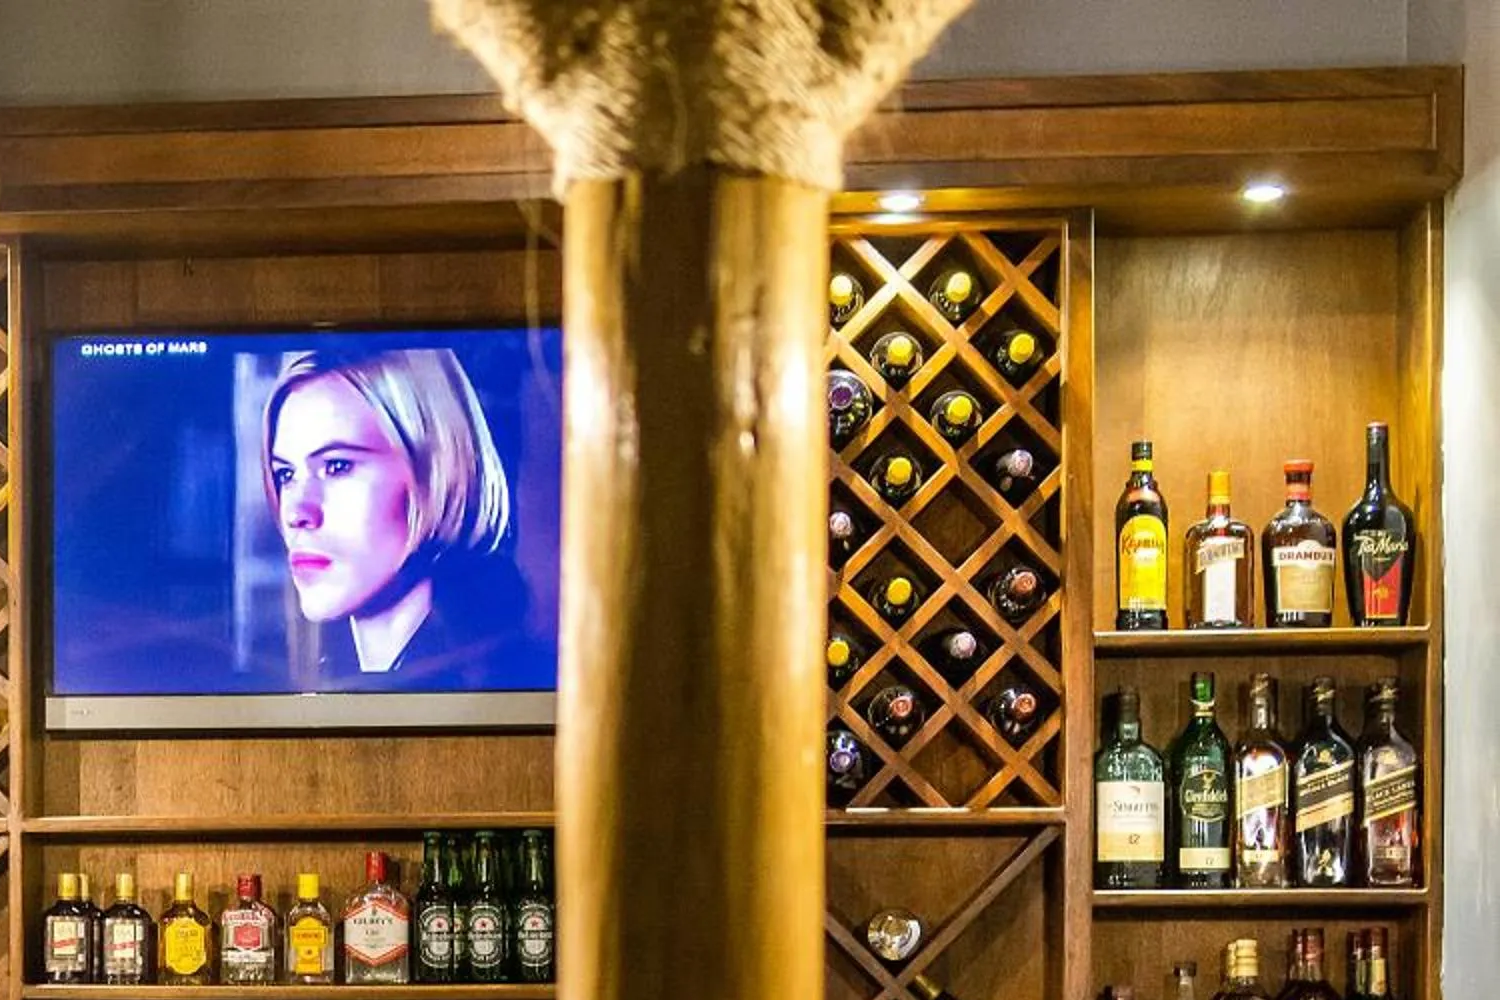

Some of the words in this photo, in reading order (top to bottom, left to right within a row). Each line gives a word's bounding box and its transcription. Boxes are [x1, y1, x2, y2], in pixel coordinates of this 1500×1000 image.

[81, 343, 142, 355] GHOSTS
[145, 342, 165, 354] OF
[168, 341, 207, 353] MARS
